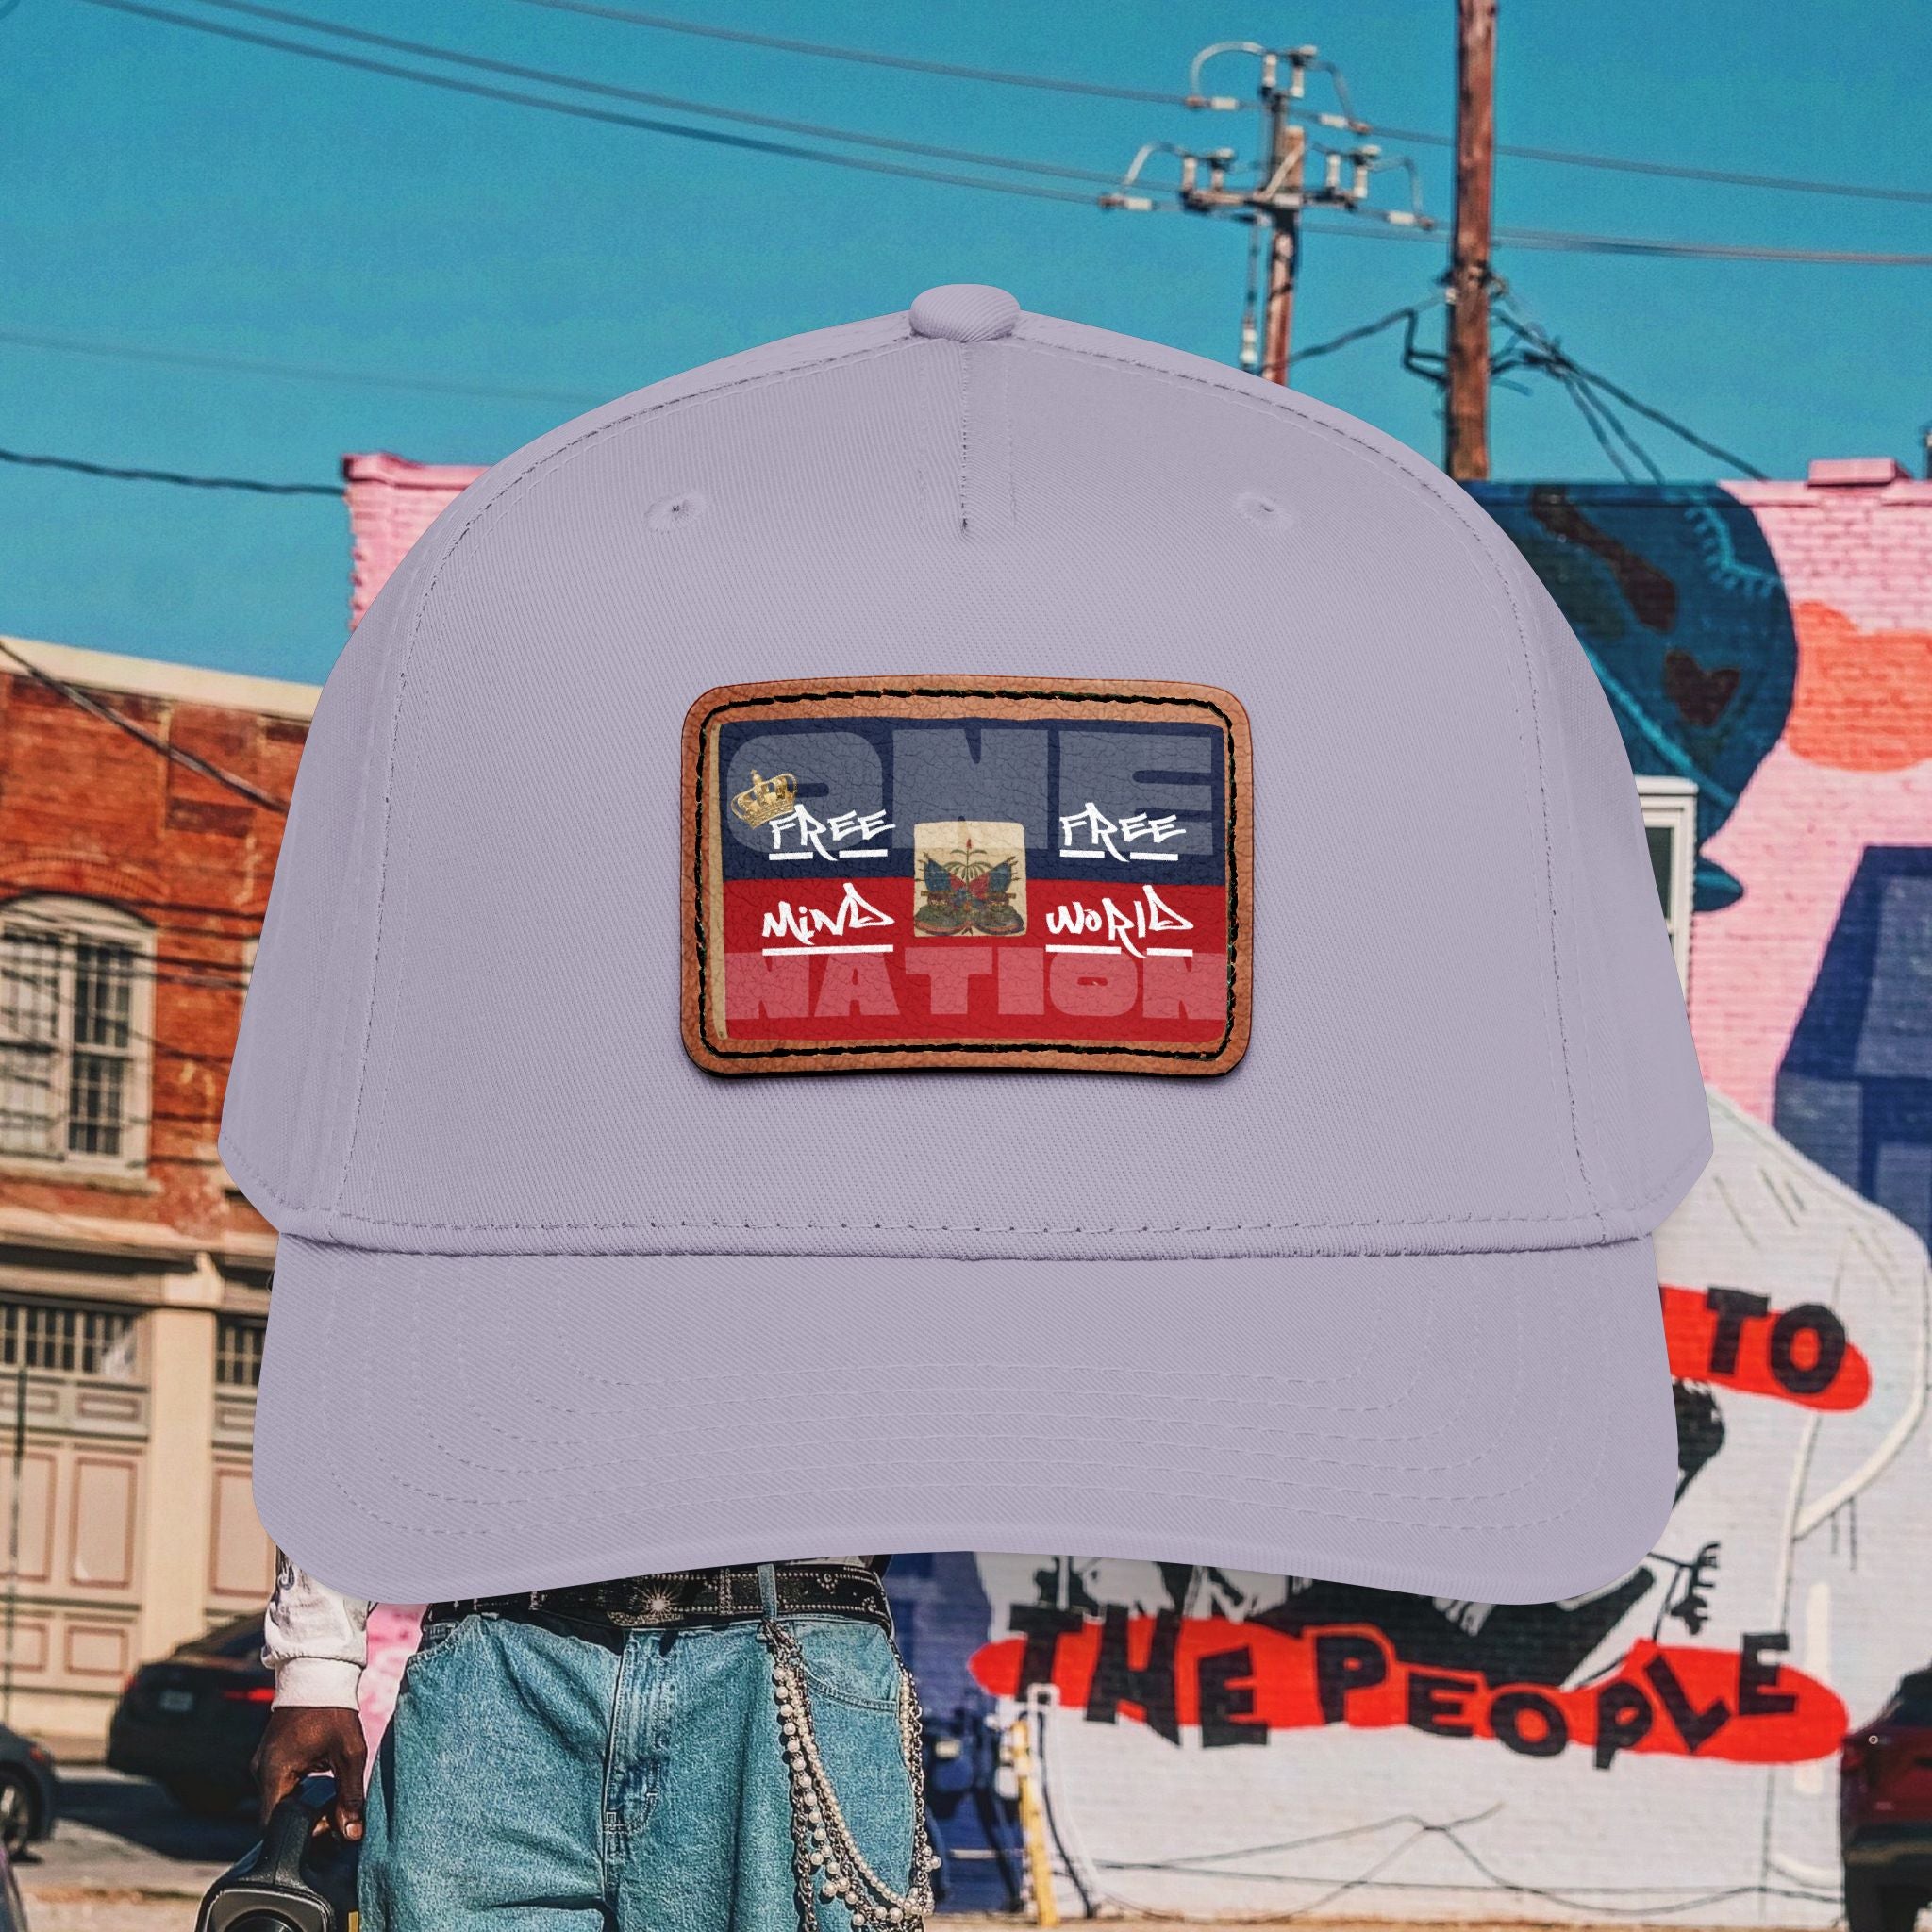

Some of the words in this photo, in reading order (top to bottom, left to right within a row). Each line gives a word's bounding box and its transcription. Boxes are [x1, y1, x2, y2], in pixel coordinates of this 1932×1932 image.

[725, 727, 1213, 856] ONE
[769, 804, 896, 861] FREE
[1059, 802, 1187, 862] FREE
[724, 946, 1227, 1021] NATION
[1706, 1287, 1846, 1394] TO
[1009, 1604, 1270, 1748] THE
[1313, 1631, 1799, 1770] PEOPLE
